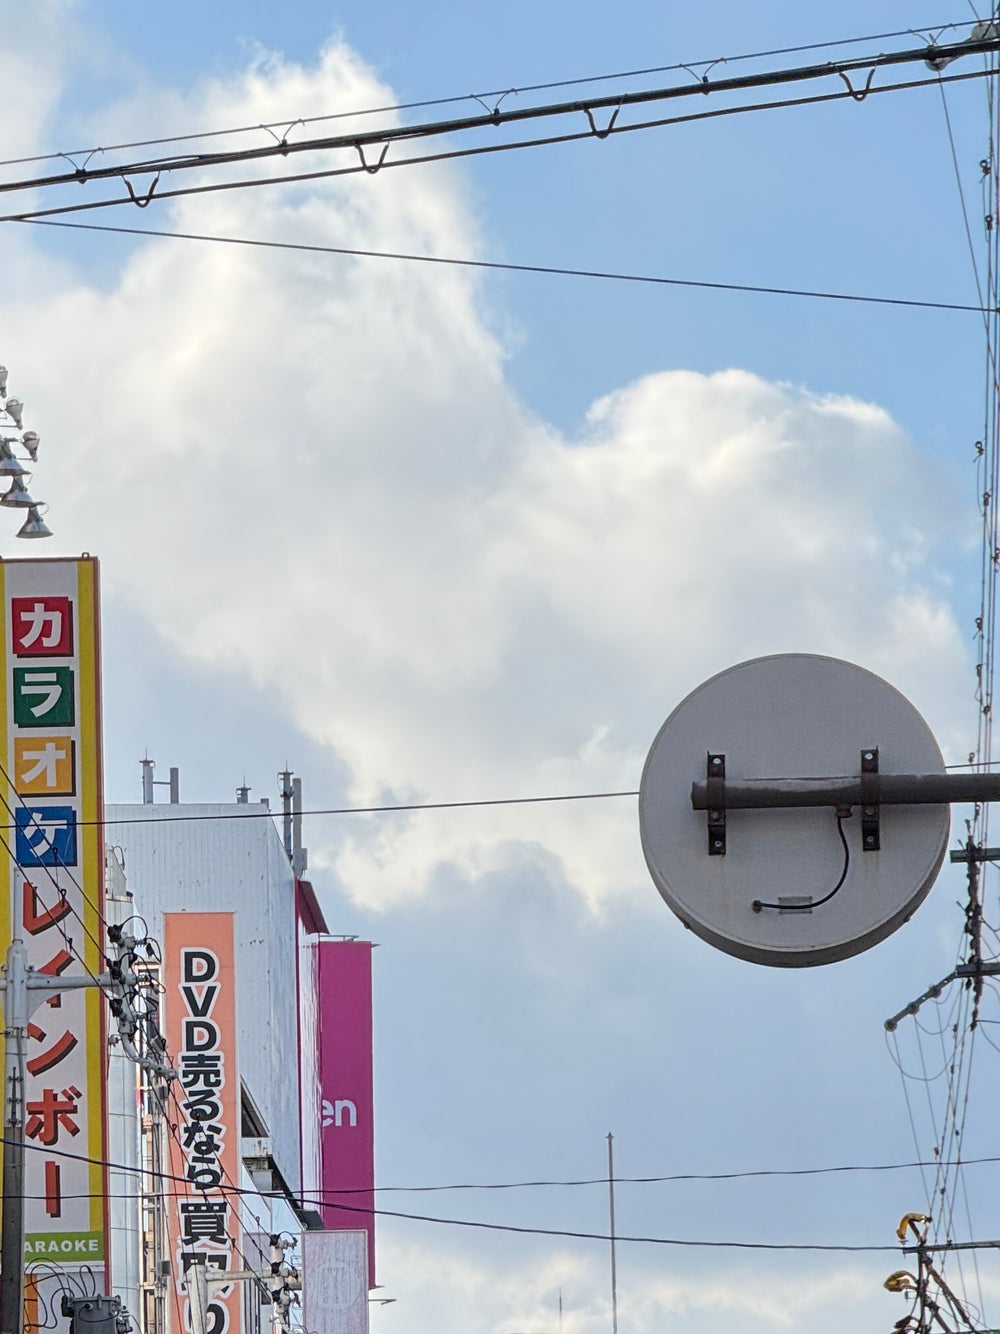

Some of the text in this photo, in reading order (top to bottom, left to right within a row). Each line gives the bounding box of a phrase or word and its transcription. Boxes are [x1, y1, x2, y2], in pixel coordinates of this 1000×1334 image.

[19, 602, 69, 857] カラオケ
[23, 882, 81, 1217] レインボー
[181, 951, 223, 1190] DVD売るなら
[23, 1239, 99, 1254] ARAOKE
